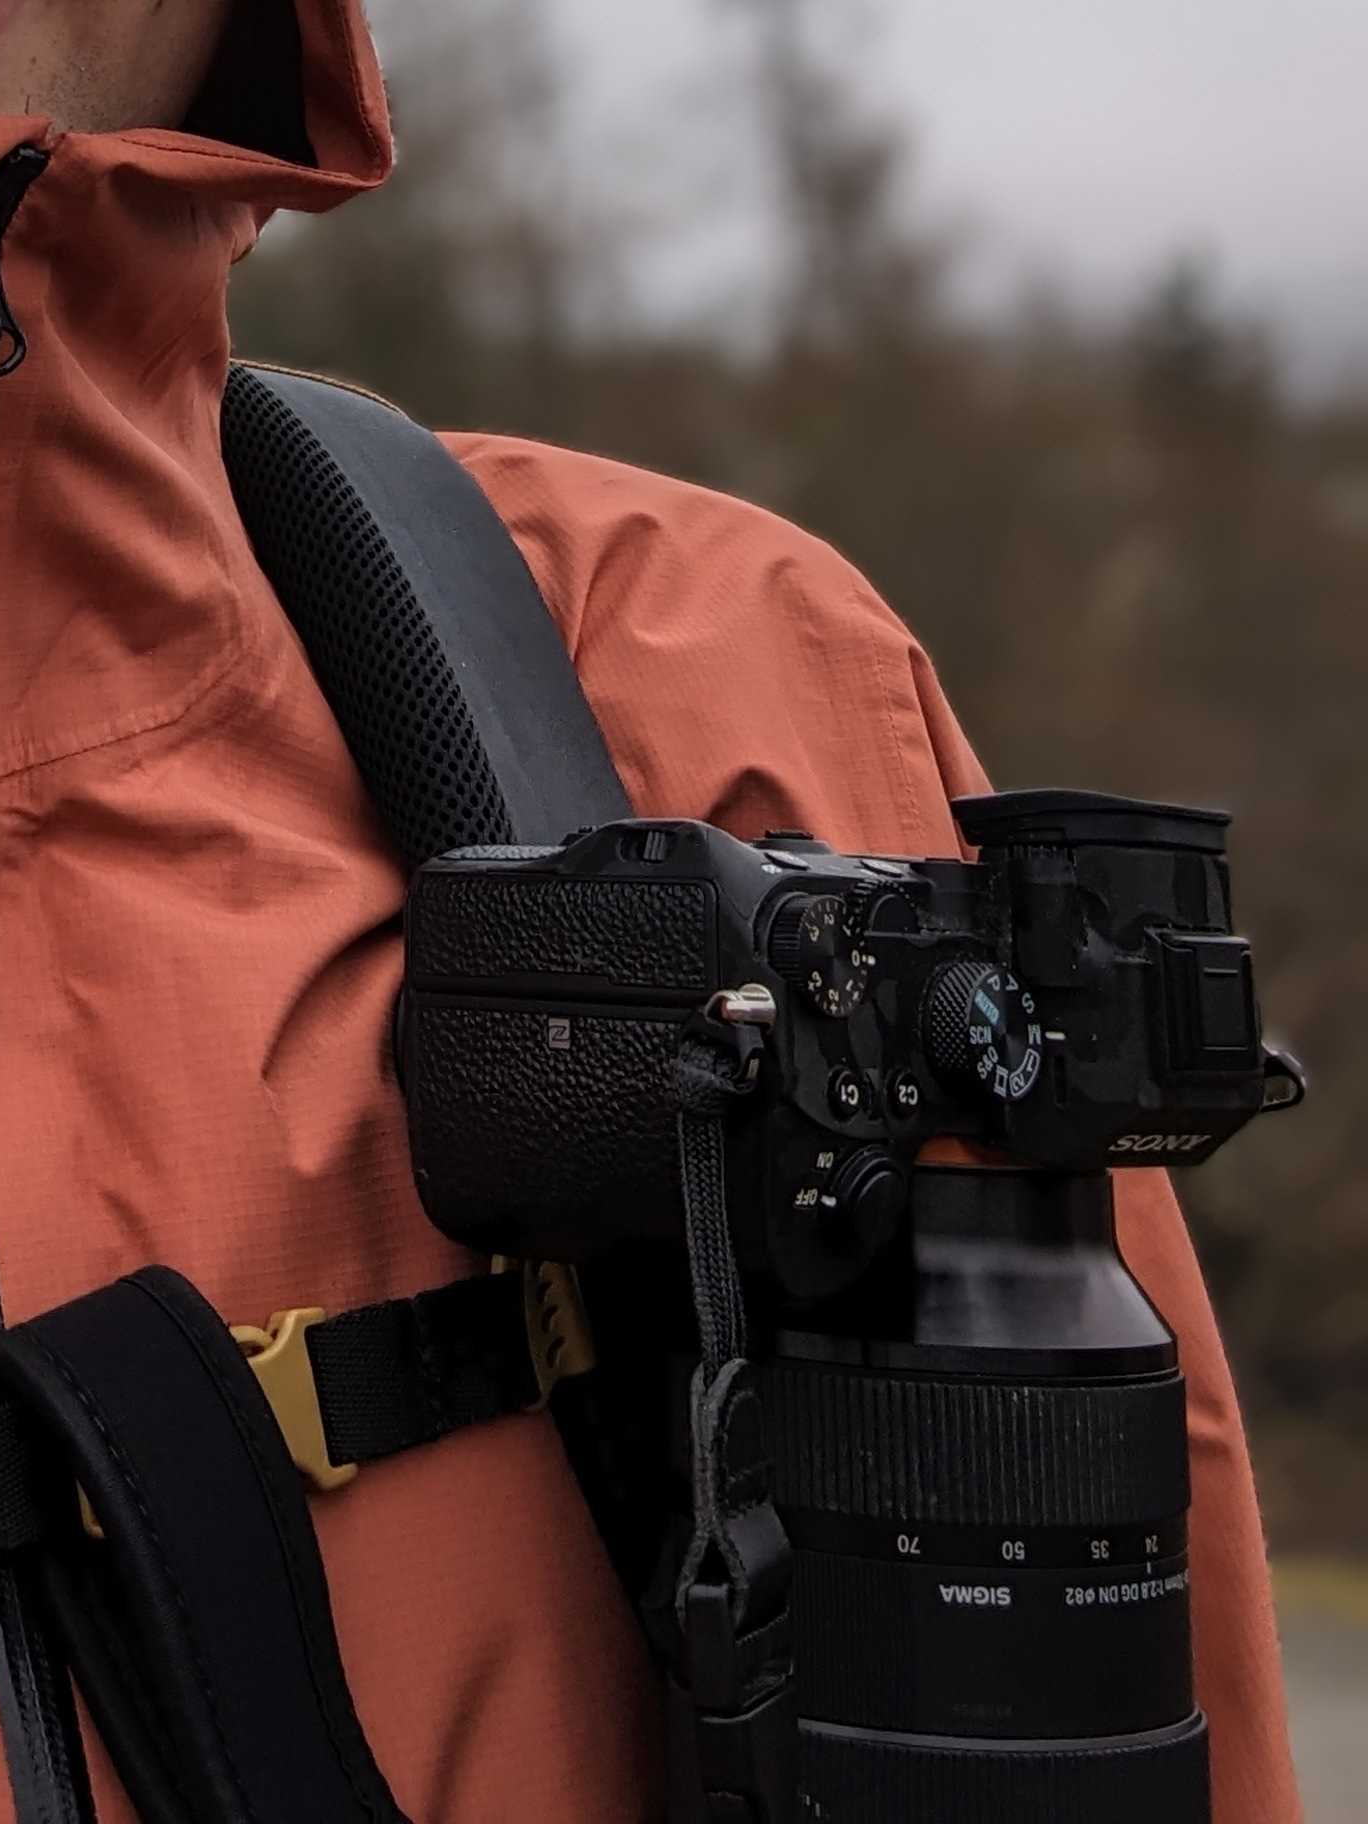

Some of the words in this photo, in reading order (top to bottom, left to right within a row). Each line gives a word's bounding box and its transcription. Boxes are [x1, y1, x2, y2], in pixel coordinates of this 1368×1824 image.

[987, 975, 1000, 991] P
[1006, 974, 1018, 991] A
[1022, 992, 1034, 1014] S
[1027, 1024, 1041, 1045] M
[1012, 1073, 1025, 1091] 2
[840, 1084, 859, 1105] C1
[898, 1084, 918, 1105] C2
[1108, 1134, 1211, 1151] SONY
[816, 1152, 834, 1168] ON
[794, 1188, 818, 1206] OFF
[897, 1534, 921, 1554] 70
[1002, 1540, 1025, 1560] 50
[1090, 1539, 1110, 1559] 35
[1145, 1535, 1158, 1553] 24
[938, 1584, 1012, 1605] SIGMA
[1099, 1585, 1119, 1603] DN
[1121, 1583, 1139, 1601] DG
